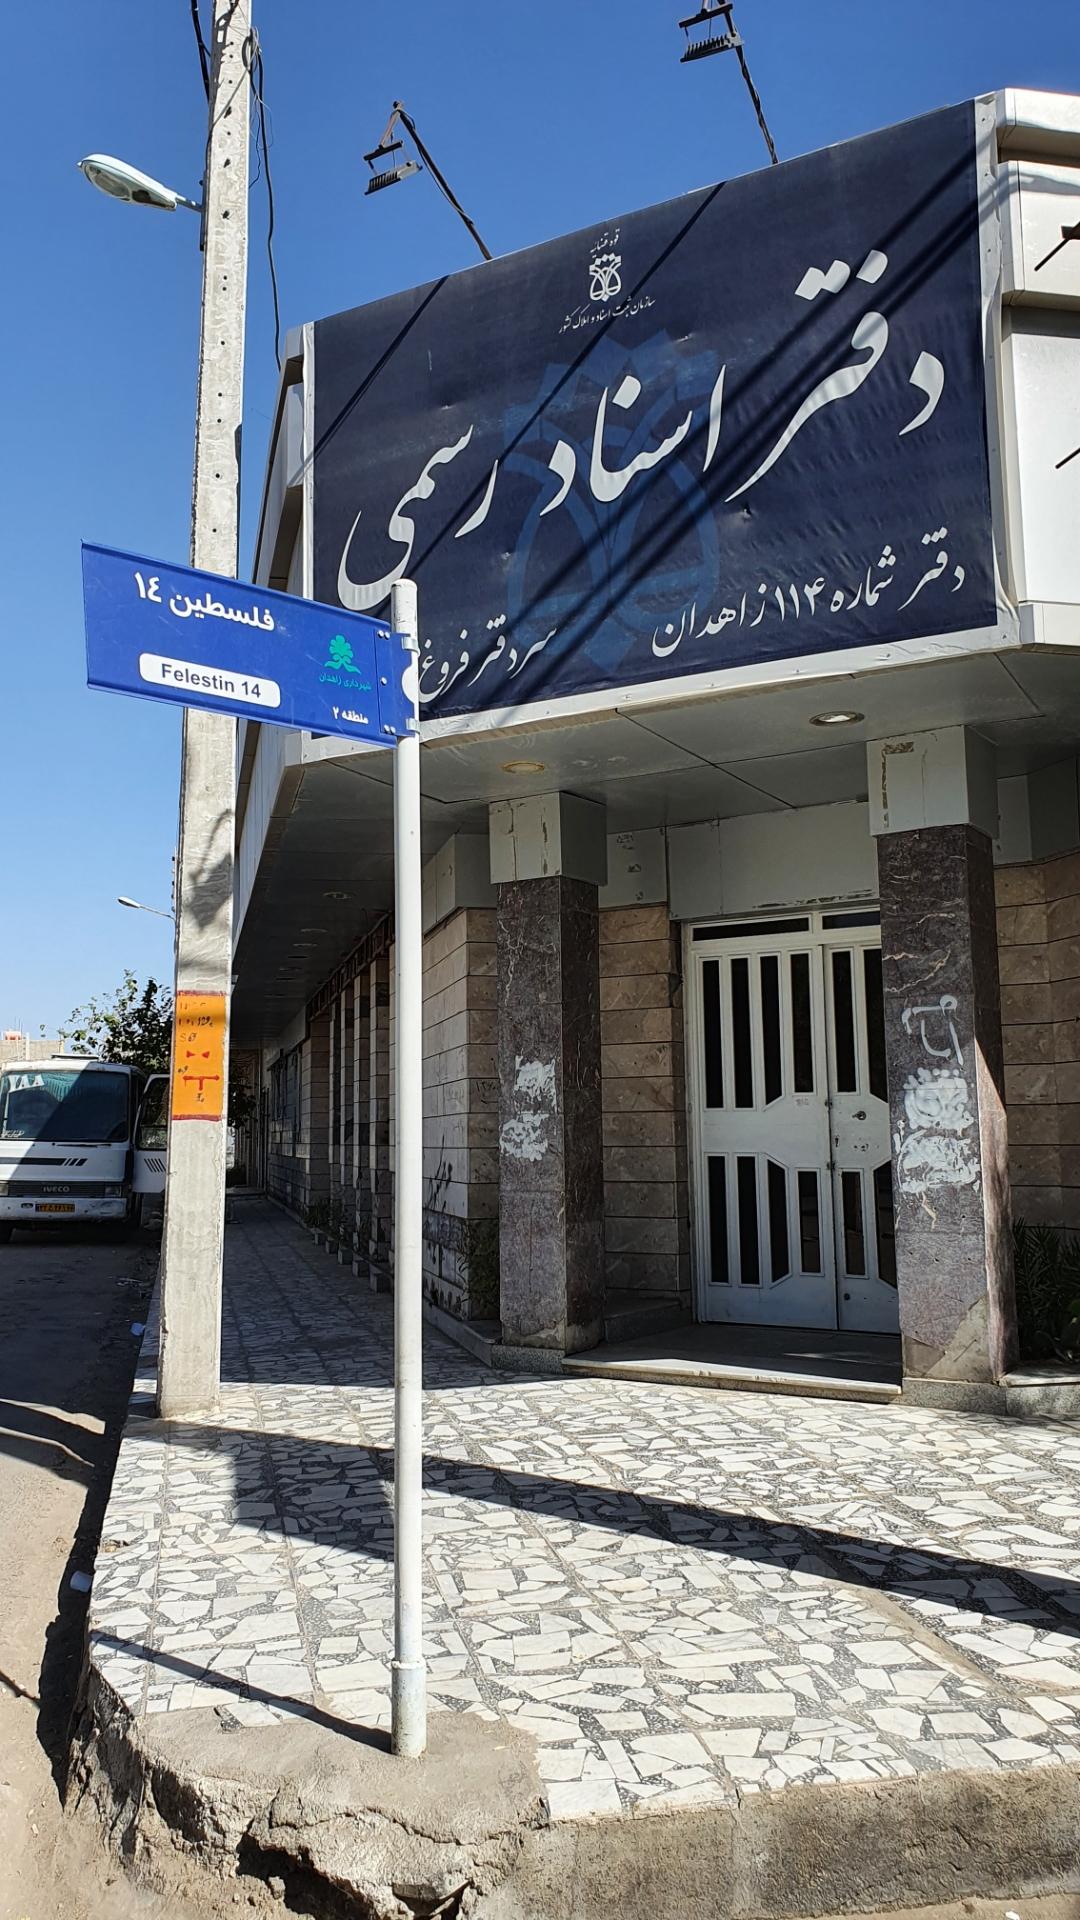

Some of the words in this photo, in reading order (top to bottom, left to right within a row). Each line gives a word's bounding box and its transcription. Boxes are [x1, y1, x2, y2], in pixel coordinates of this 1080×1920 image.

[724, 249, 946, 503] دفتر
[539, 363, 727, 518] اسناد
[337, 423, 499, 612] رسمی
[773, 576, 827, 622] ۱۱۴
[829, 544, 897, 613] شماره
[897, 526, 966, 612] دفتر
[169, 592, 275, 632] فلسطین
[651, 582, 768, 658] زاهدان
[161, 662, 236, 694] Felestin
[240, 680, 262, 699] 14
[341, 709, 369, 725] منطقه
[42, 1185, 71, 1193] IVECO
